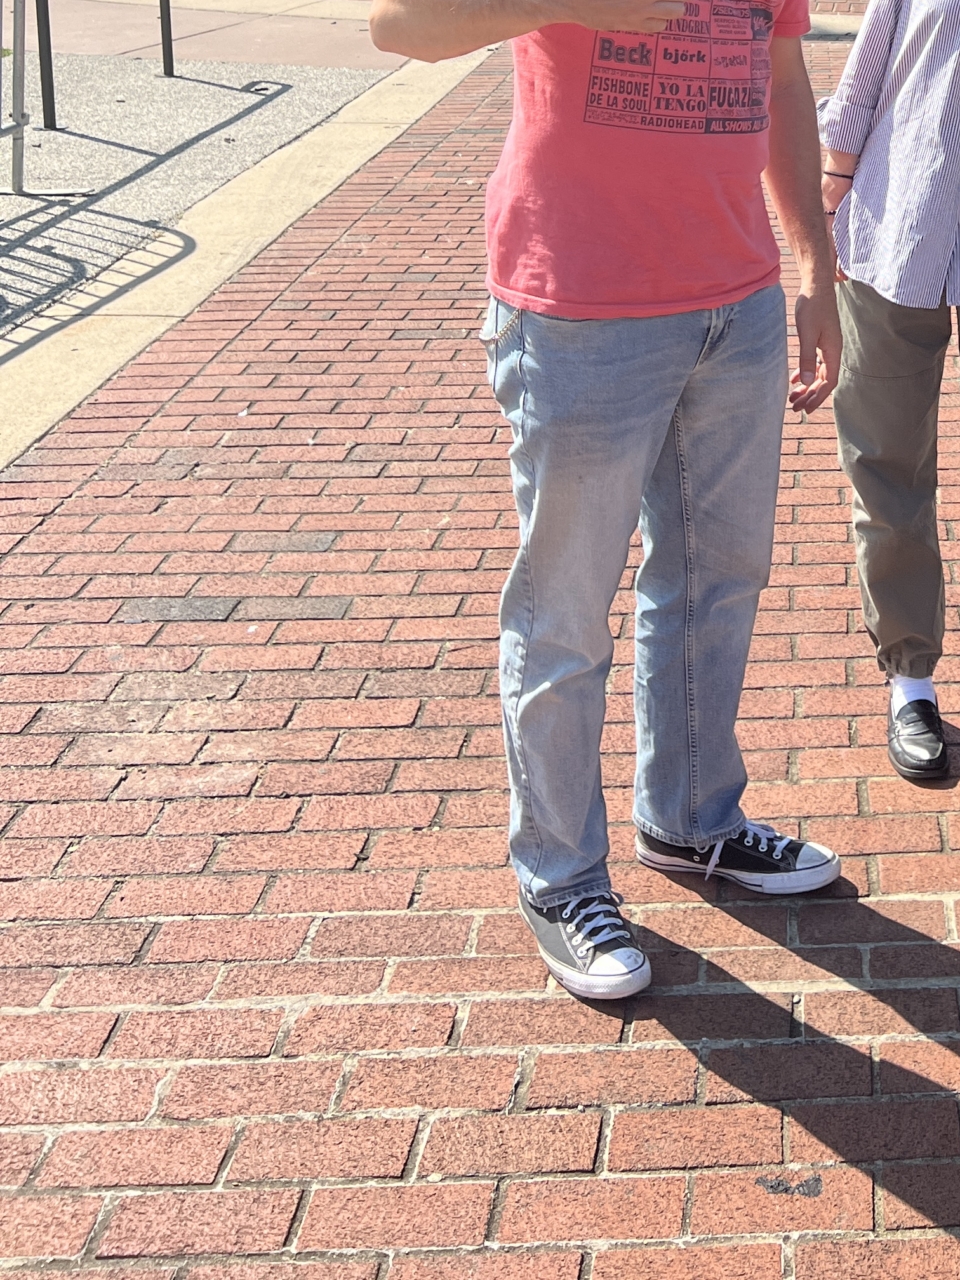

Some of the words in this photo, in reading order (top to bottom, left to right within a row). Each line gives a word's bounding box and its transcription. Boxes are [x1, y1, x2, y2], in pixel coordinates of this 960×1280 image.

[599, 38, 652, 66] Beck
[663, 47, 707, 65] björk
[591, 75, 650, 98] FISHBONE
[658, 81, 680, 96] YO
[686, 84, 705, 98] LA
[589, 92, 603, 105] DE
[606, 95, 618, 108] LA
[622, 97, 649, 112] SOUL
[653, 96, 707, 113] TENGO
[709, 86, 751, 109] FUGAZI
[640, 116, 704, 130] RADIOHEAD
